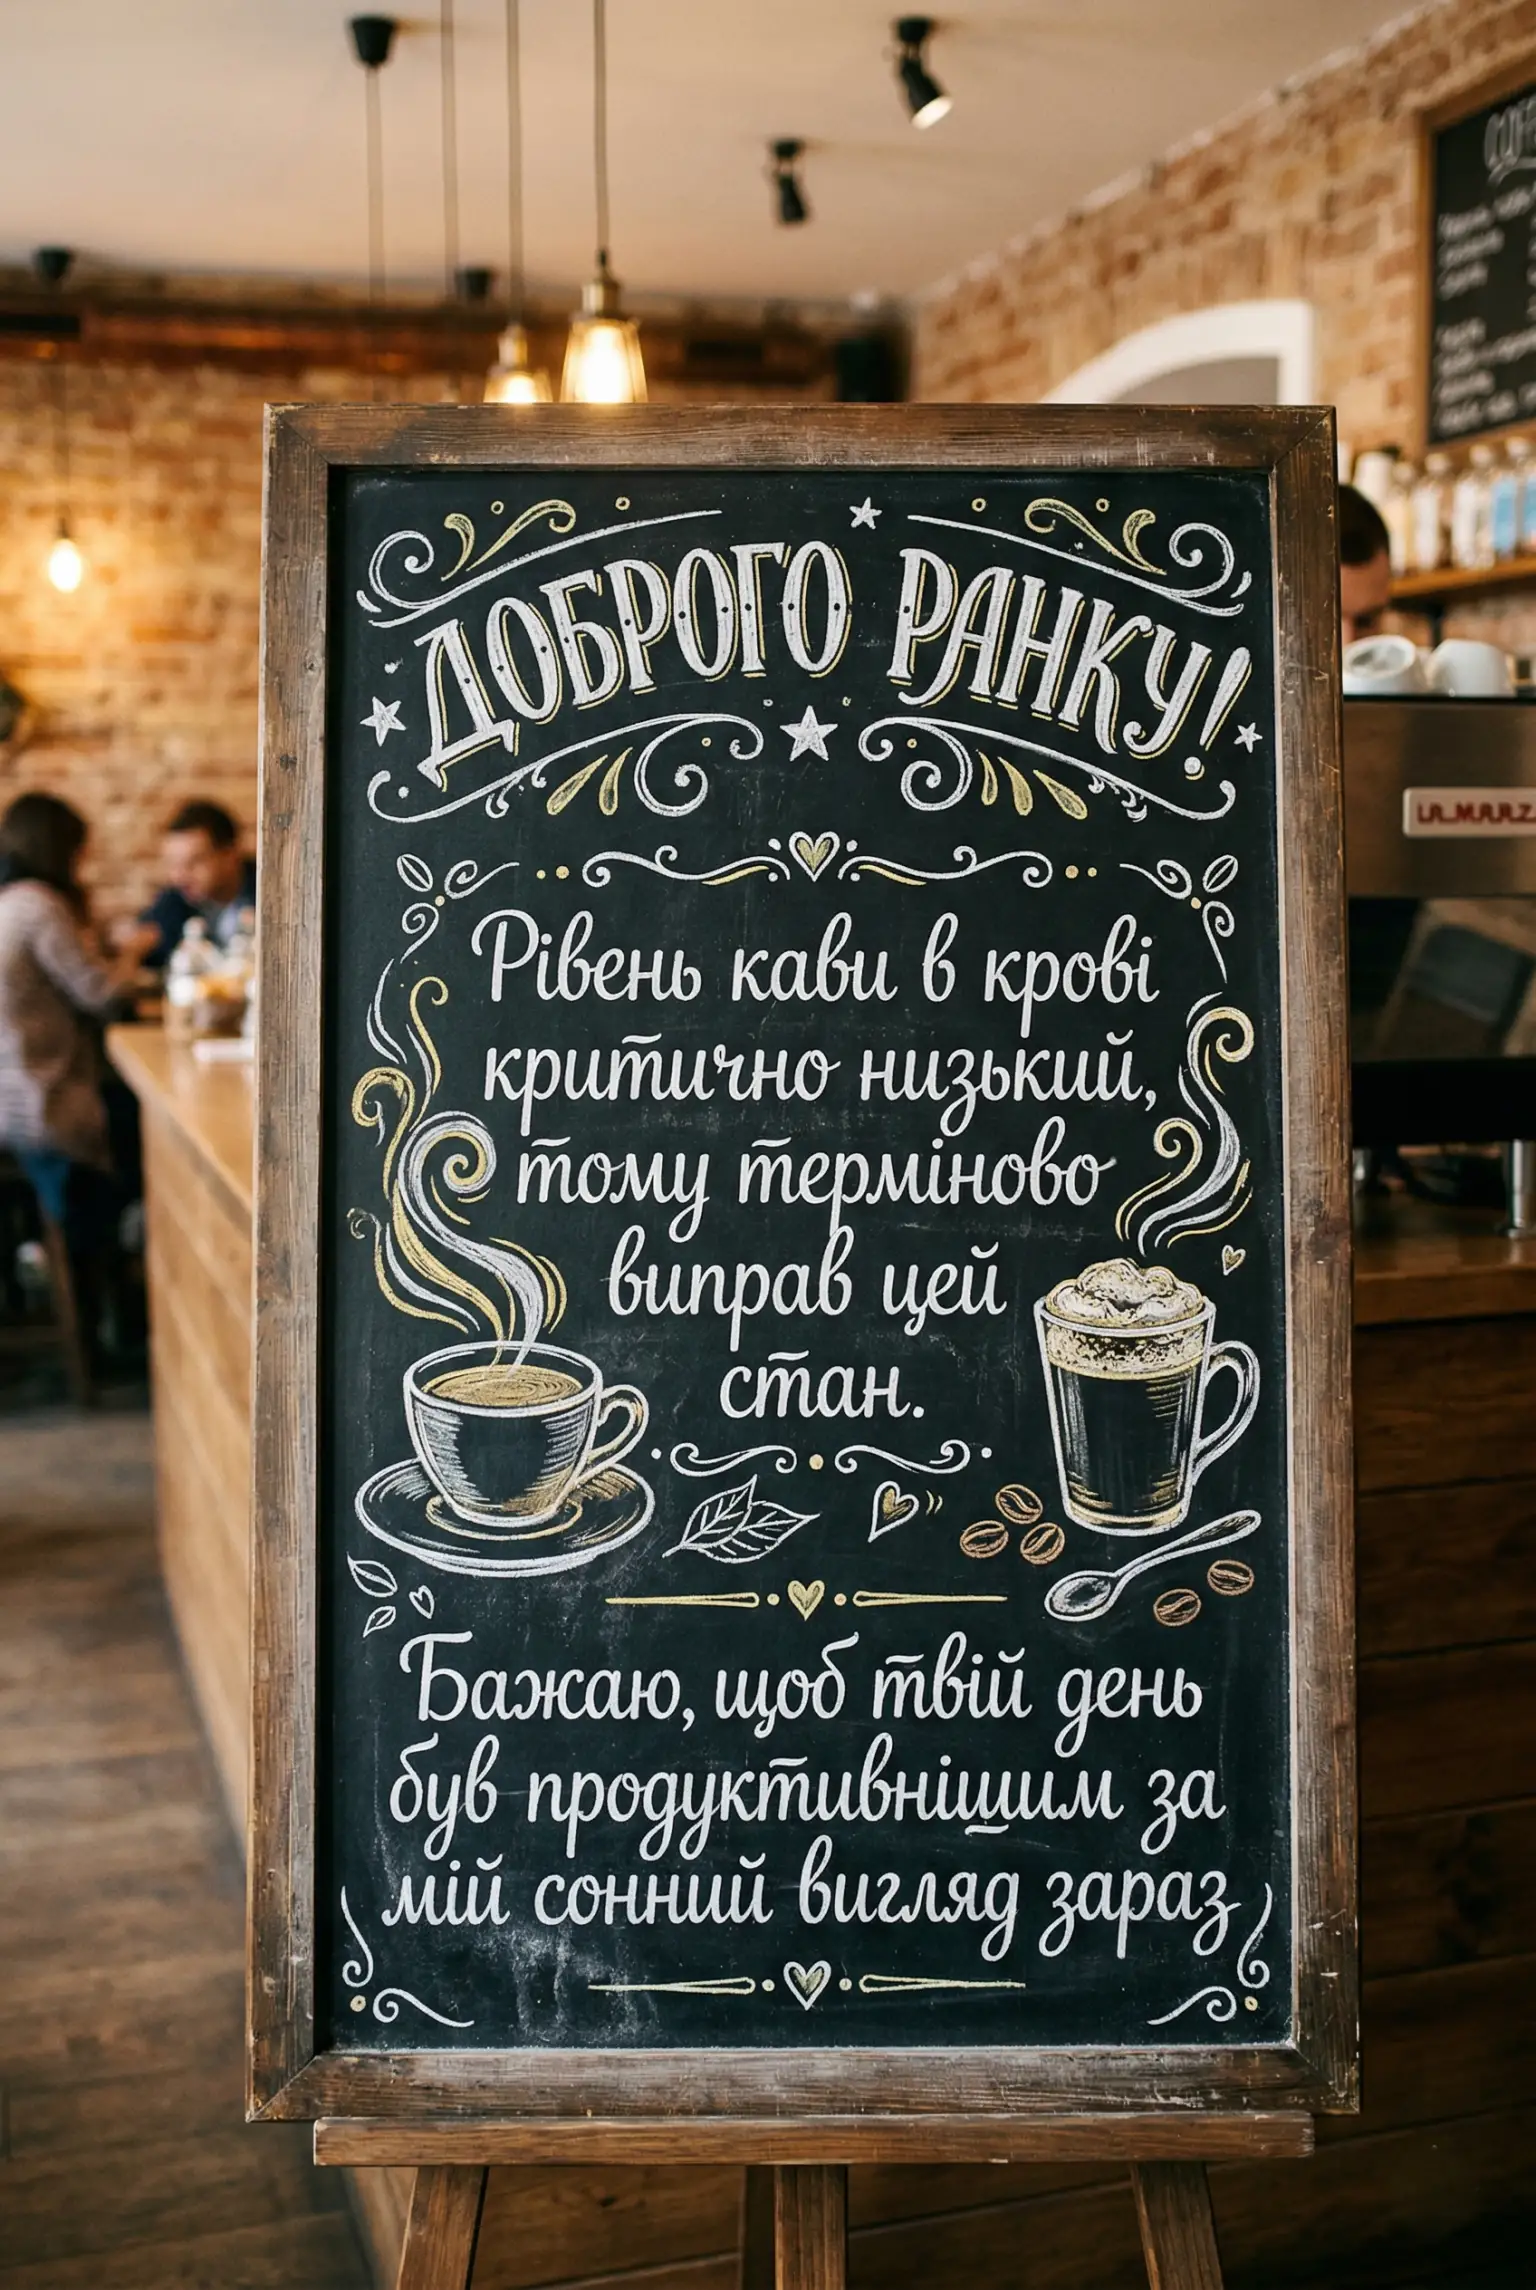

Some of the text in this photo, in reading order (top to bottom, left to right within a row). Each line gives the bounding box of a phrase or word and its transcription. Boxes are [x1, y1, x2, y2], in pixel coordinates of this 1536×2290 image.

[414, 541, 1251, 789] ДОБРОГО РАНКУ!
[472, 909, 1159, 1045] Рівень кави в крові
[485, 1030, 1156, 1136] критично низький,
[517, 1116, 1116, 1243] тому терміново
[607, 1225, 1007, 1352] виправ цей
[720, 1351, 924, 1418] стан.
[400, 1631, 1202, 1757] Бажаю, щоб твій день
[390, 1733, 1226, 1861] був продуктивнішим за
[382, 1835, 1241, 1961] мій сонний вигляд зараз
